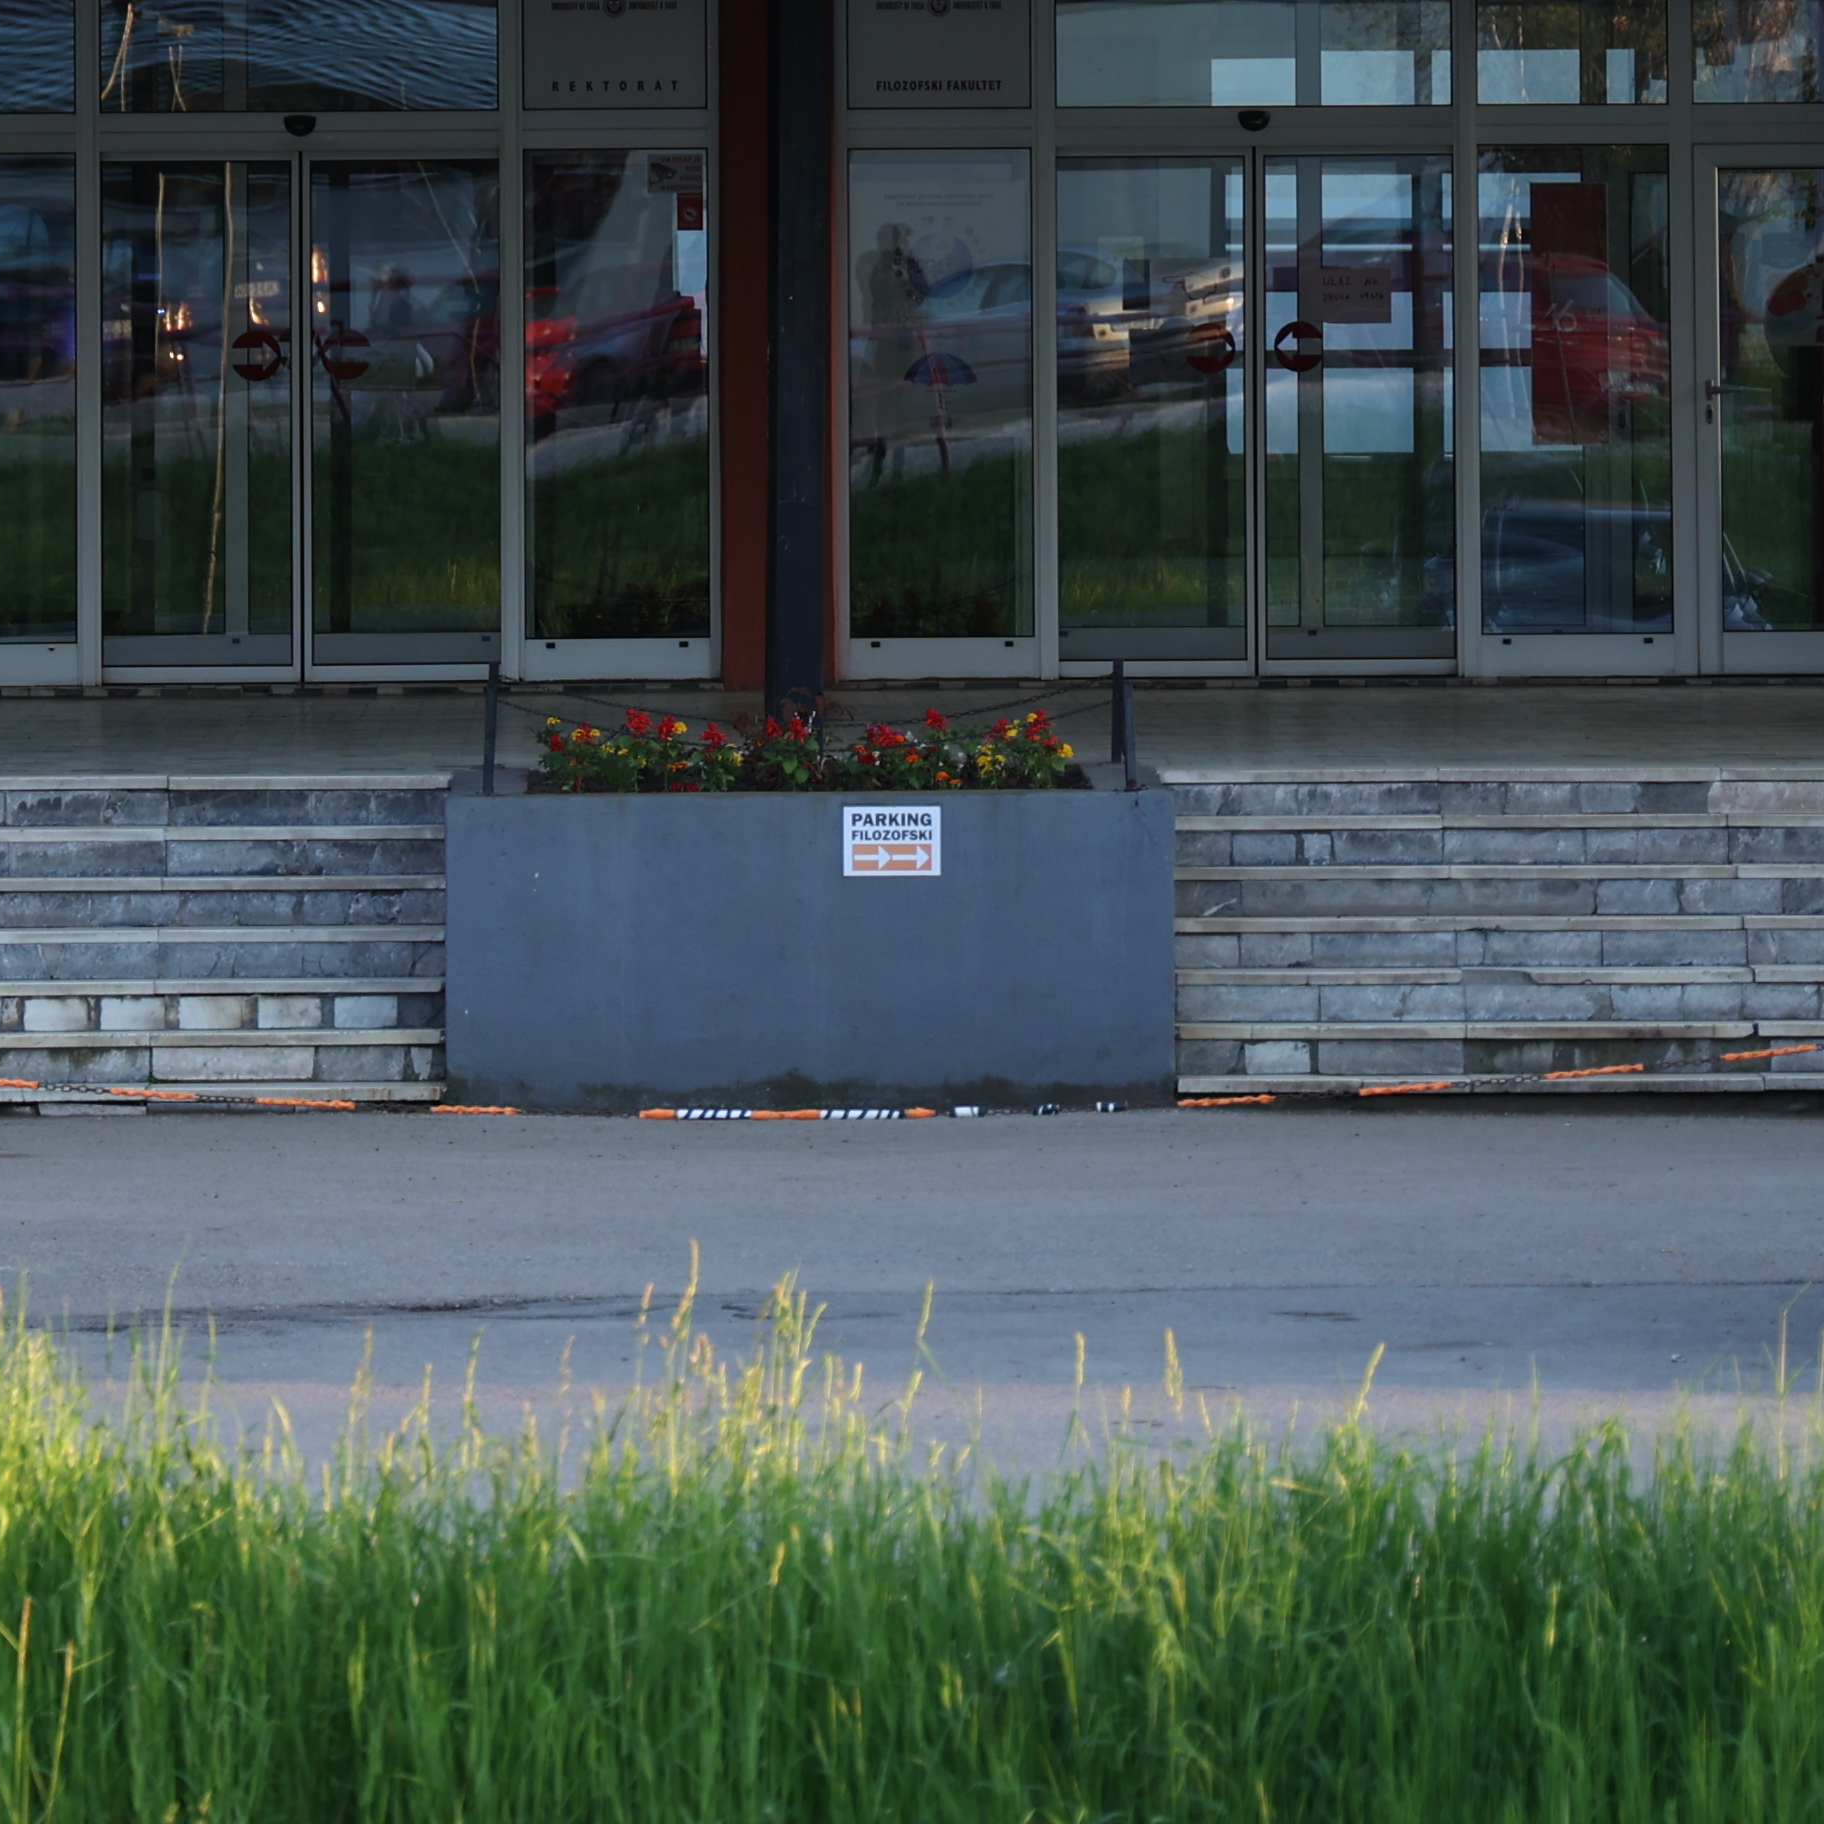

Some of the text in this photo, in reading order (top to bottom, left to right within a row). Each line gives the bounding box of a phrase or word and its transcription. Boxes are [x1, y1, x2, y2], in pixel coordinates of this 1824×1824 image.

[552, 80, 678, 91] REKTORAT
[876, 80, 1002, 91] FILOZOFSKI FAKULTET
[1323, 276, 1352, 286] ULAZ
[851, 812, 932, 827] PARKING
[851, 829, 932, 841] FILOZOFSKI
